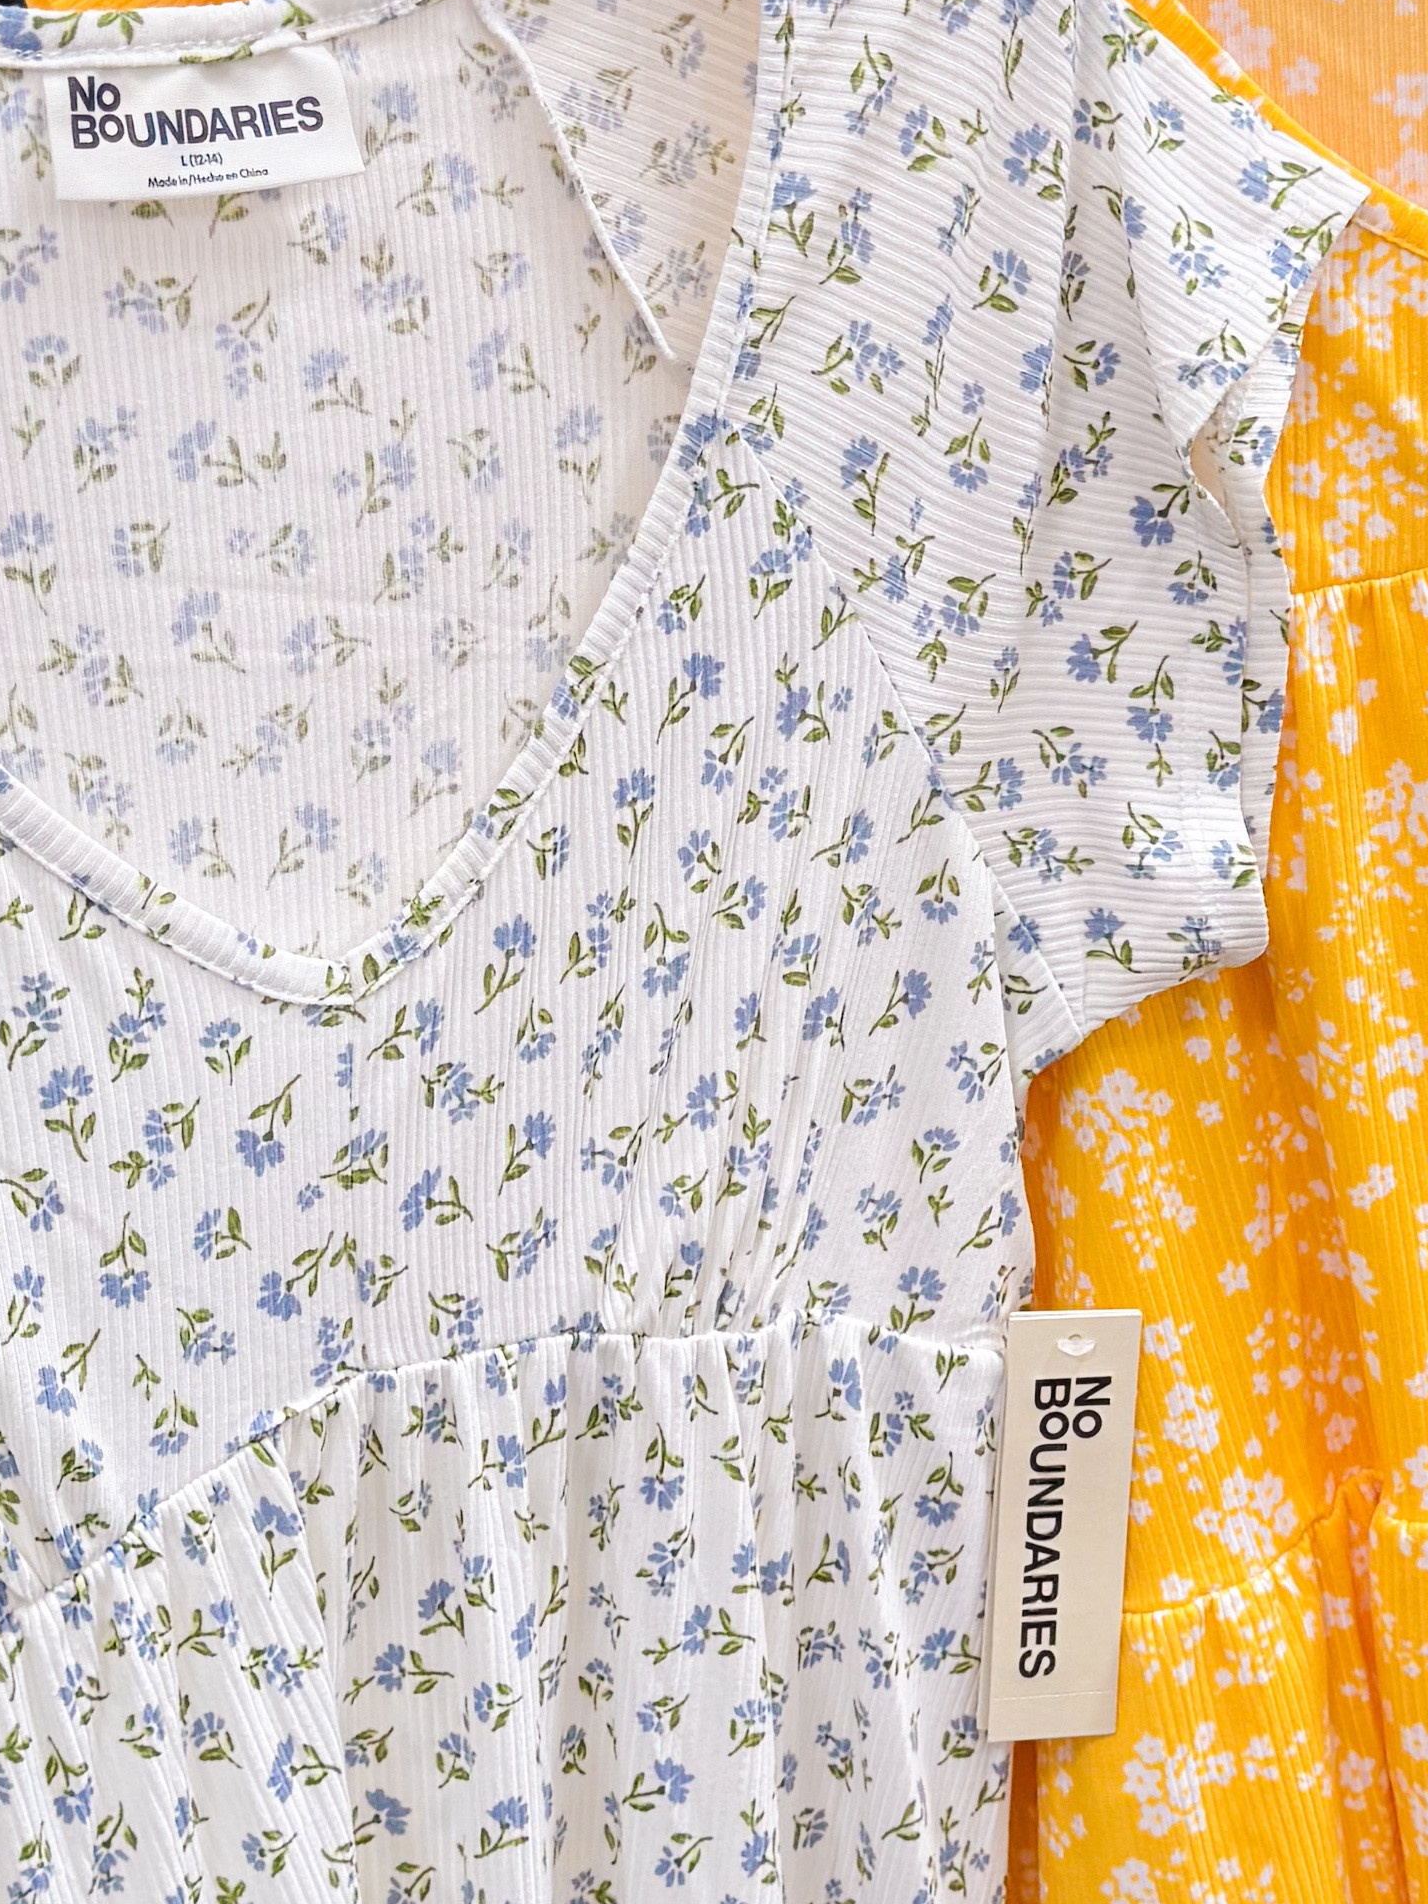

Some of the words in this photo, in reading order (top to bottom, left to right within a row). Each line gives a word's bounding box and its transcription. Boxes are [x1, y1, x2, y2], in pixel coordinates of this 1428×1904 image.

[67, 75, 122, 113] No
[71, 95, 324, 150] BOUNDARIES
[147, 176, 178, 189] Made
[239, 167, 270, 179] China
[180, 155, 189, 167] L
[1071, 1374, 1113, 1439] No
[1017, 1376, 1073, 1680] BOUNDARIES
